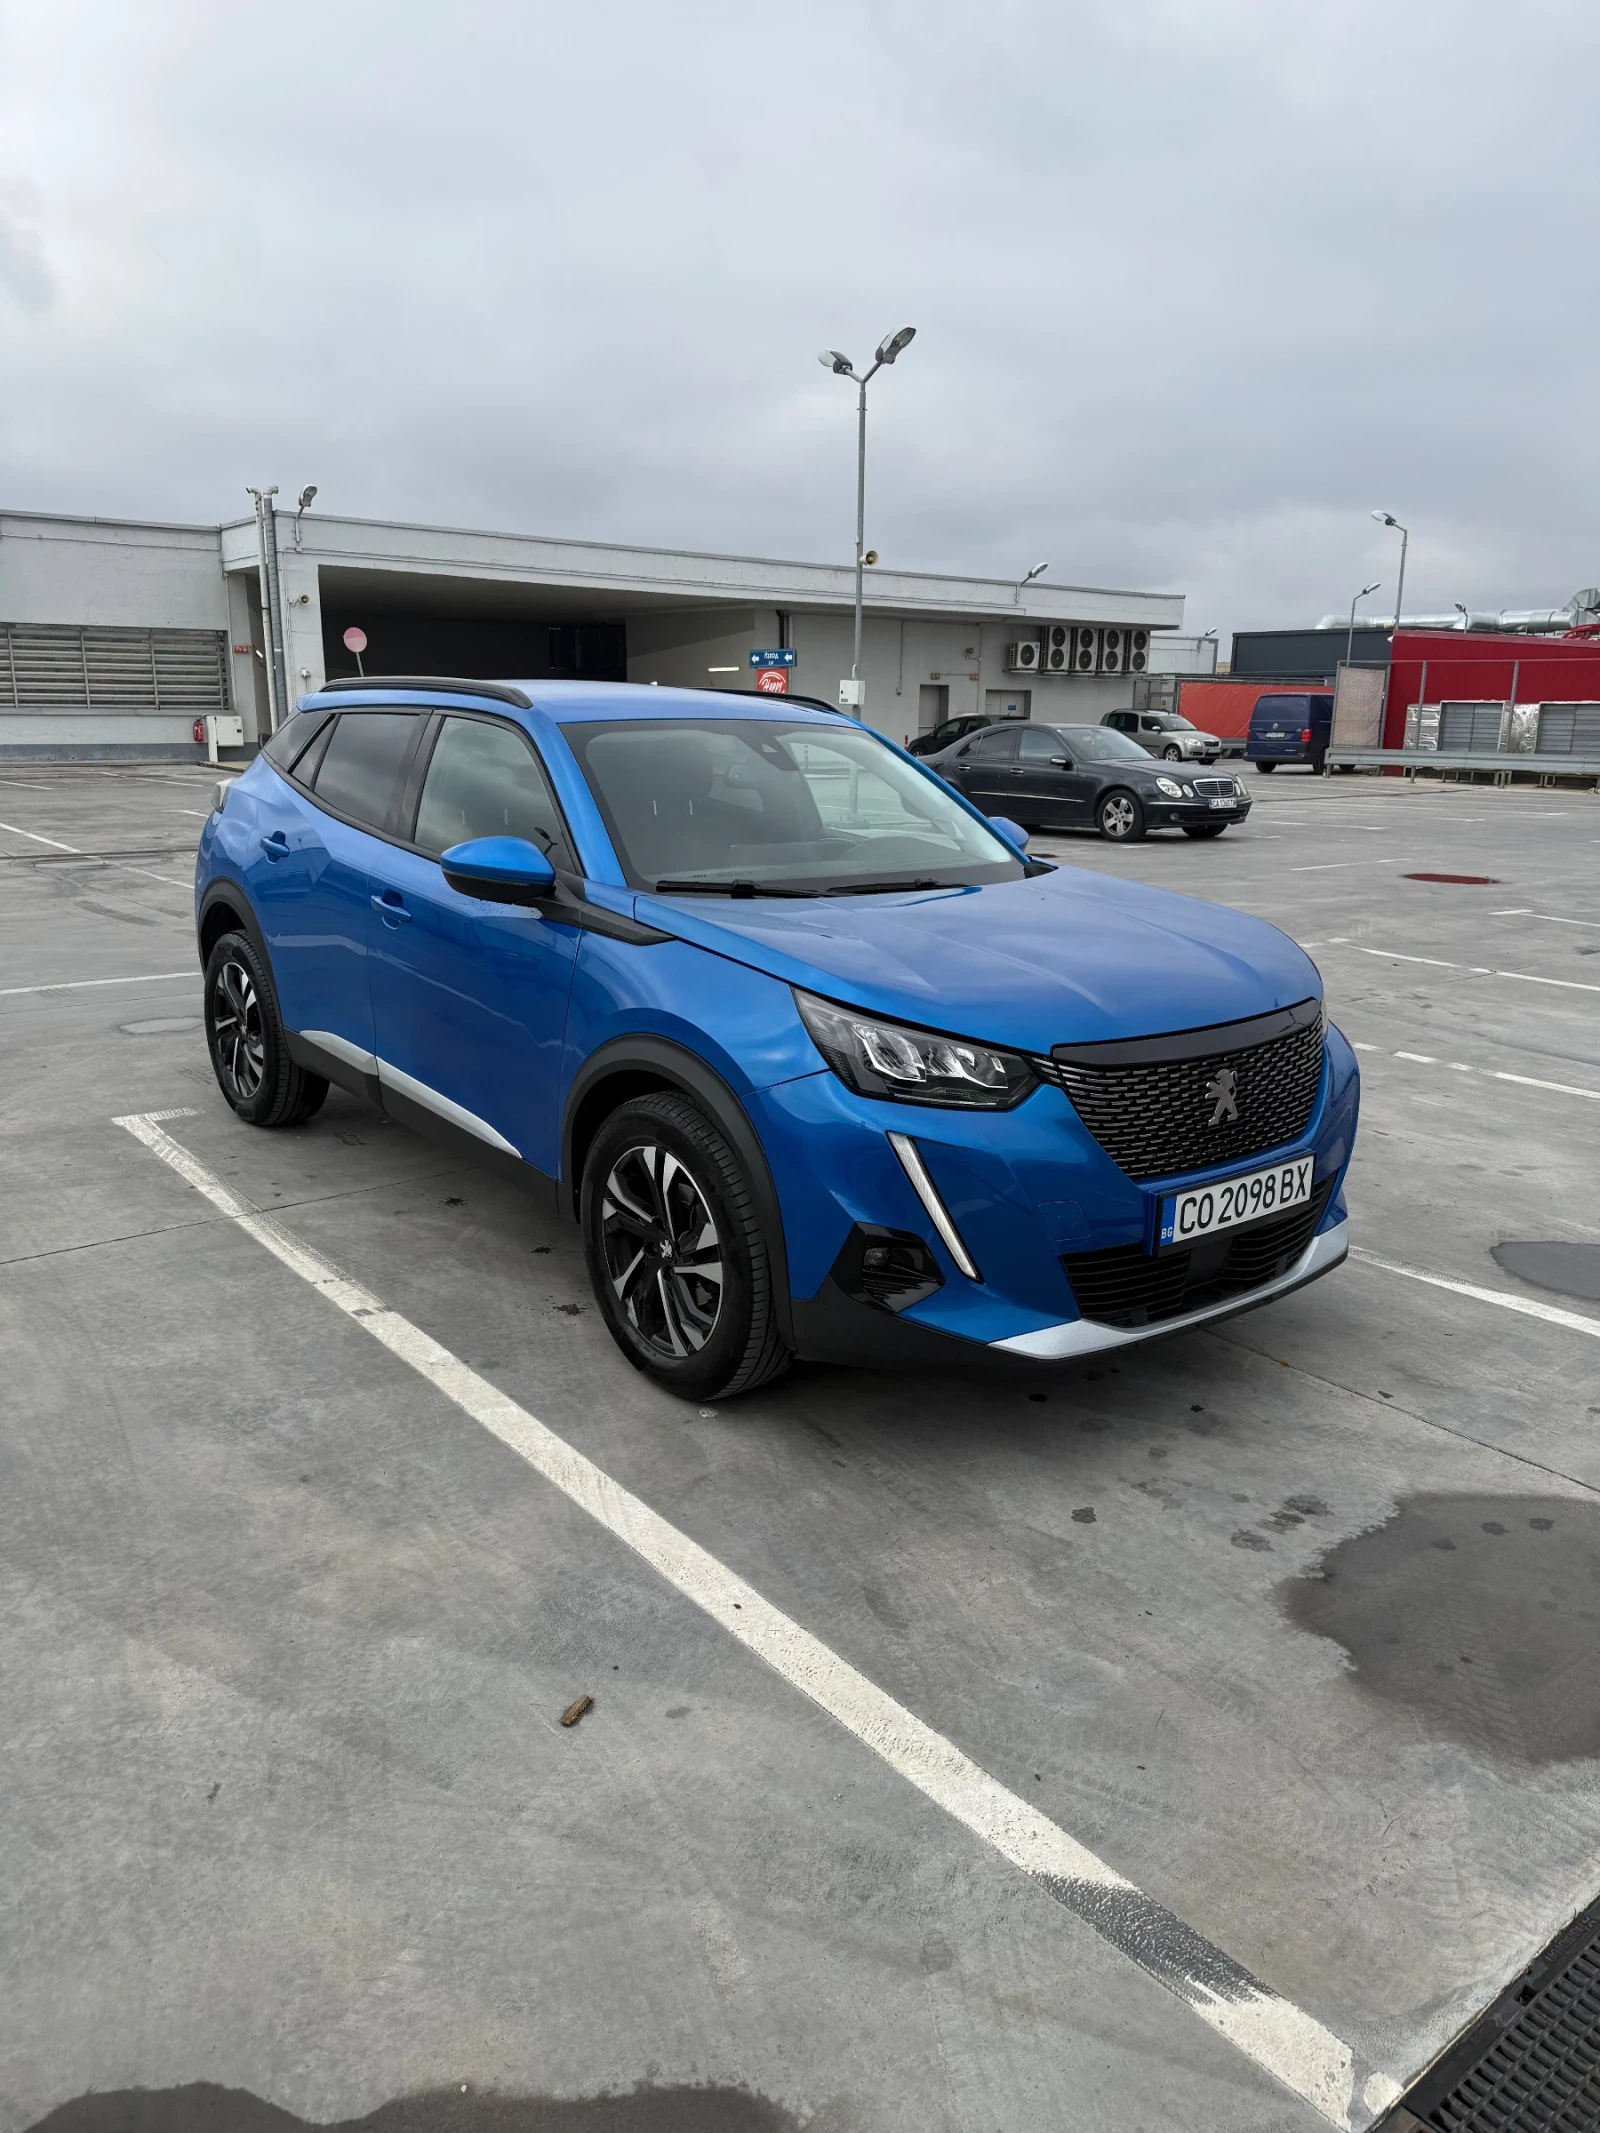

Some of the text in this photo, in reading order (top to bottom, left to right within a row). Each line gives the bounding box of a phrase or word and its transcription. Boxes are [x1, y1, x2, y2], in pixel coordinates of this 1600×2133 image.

[1179, 1162, 1310, 1234] CO 2098 BX
[1161, 1227, 1173, 1240] BG
